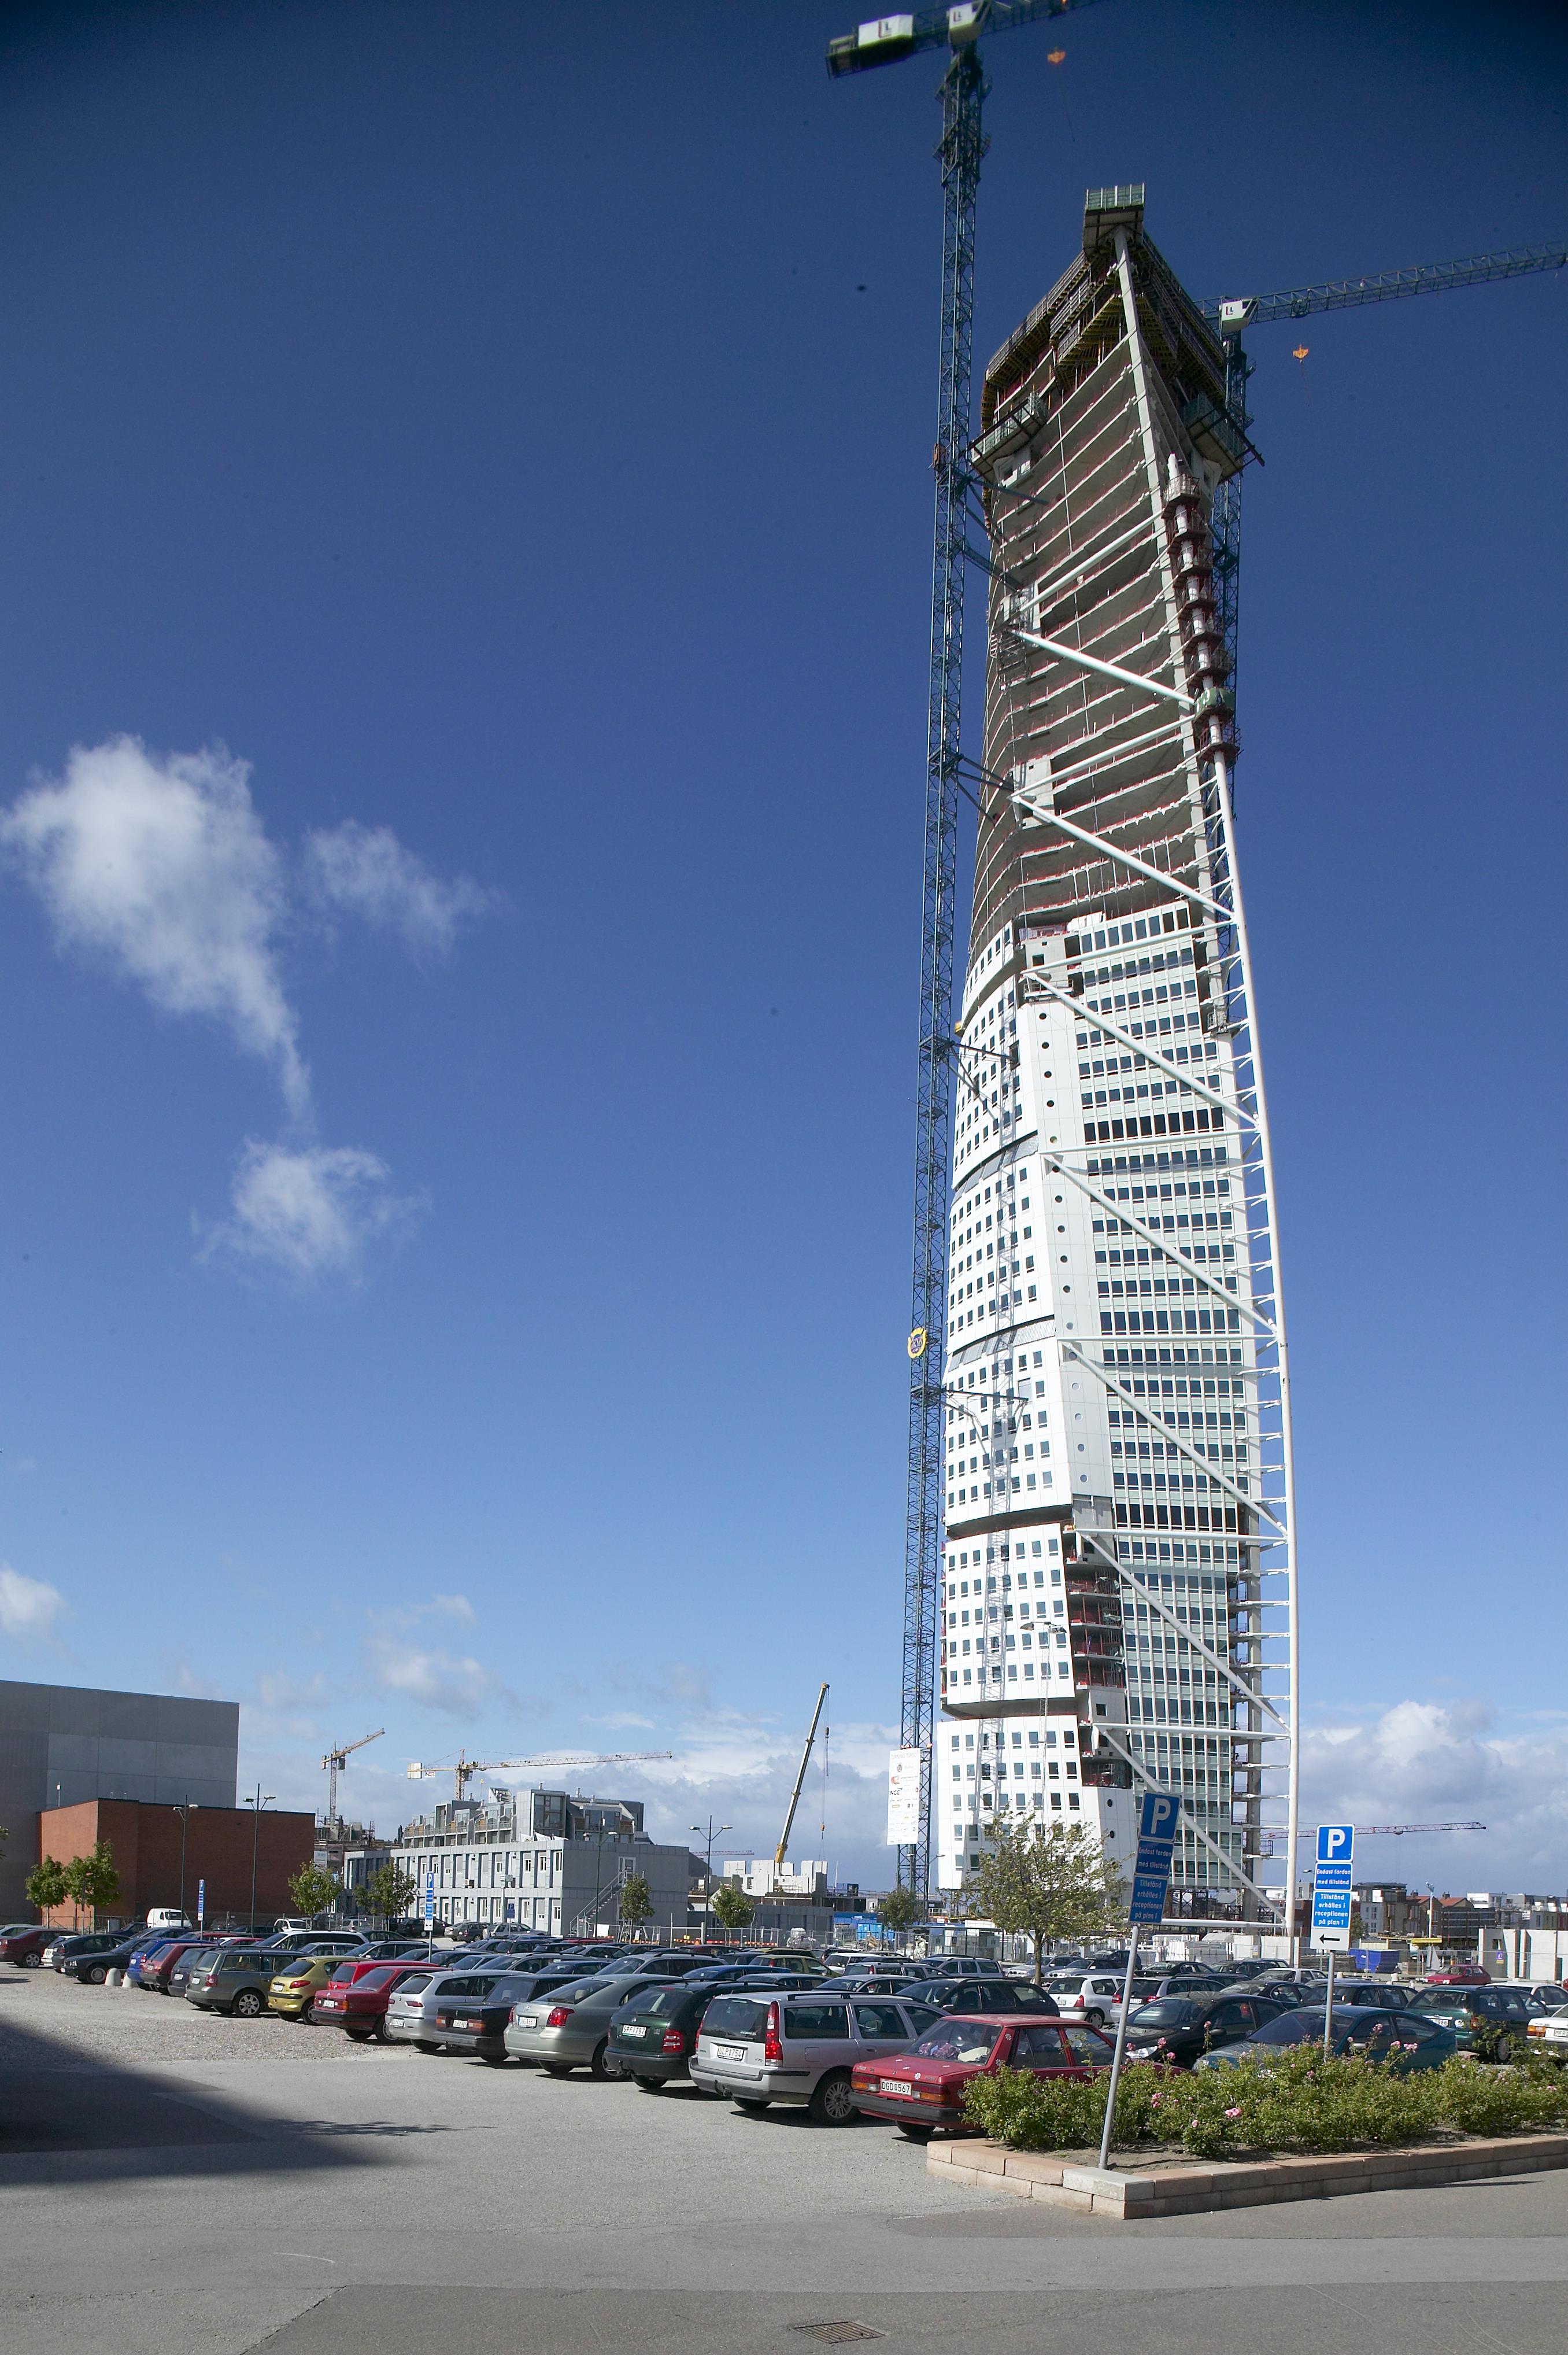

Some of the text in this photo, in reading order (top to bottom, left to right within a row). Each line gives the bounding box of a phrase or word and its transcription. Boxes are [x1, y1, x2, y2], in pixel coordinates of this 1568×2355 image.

[1151, 1797, 1171, 1834] P
[1327, 1829, 1345, 1858] P
[1138, 1847, 1155, 1855] Endast
[428, 1873, 432, 1888] P
[1140, 1879, 1162, 1888] Tillstånd
[1137, 1891, 1158, 1899] erhålles
[1133, 1901, 1163, 1910] receptionen
[1134, 1911, 1142, 1920] på
[898, 2083, 910, 2094] 567
